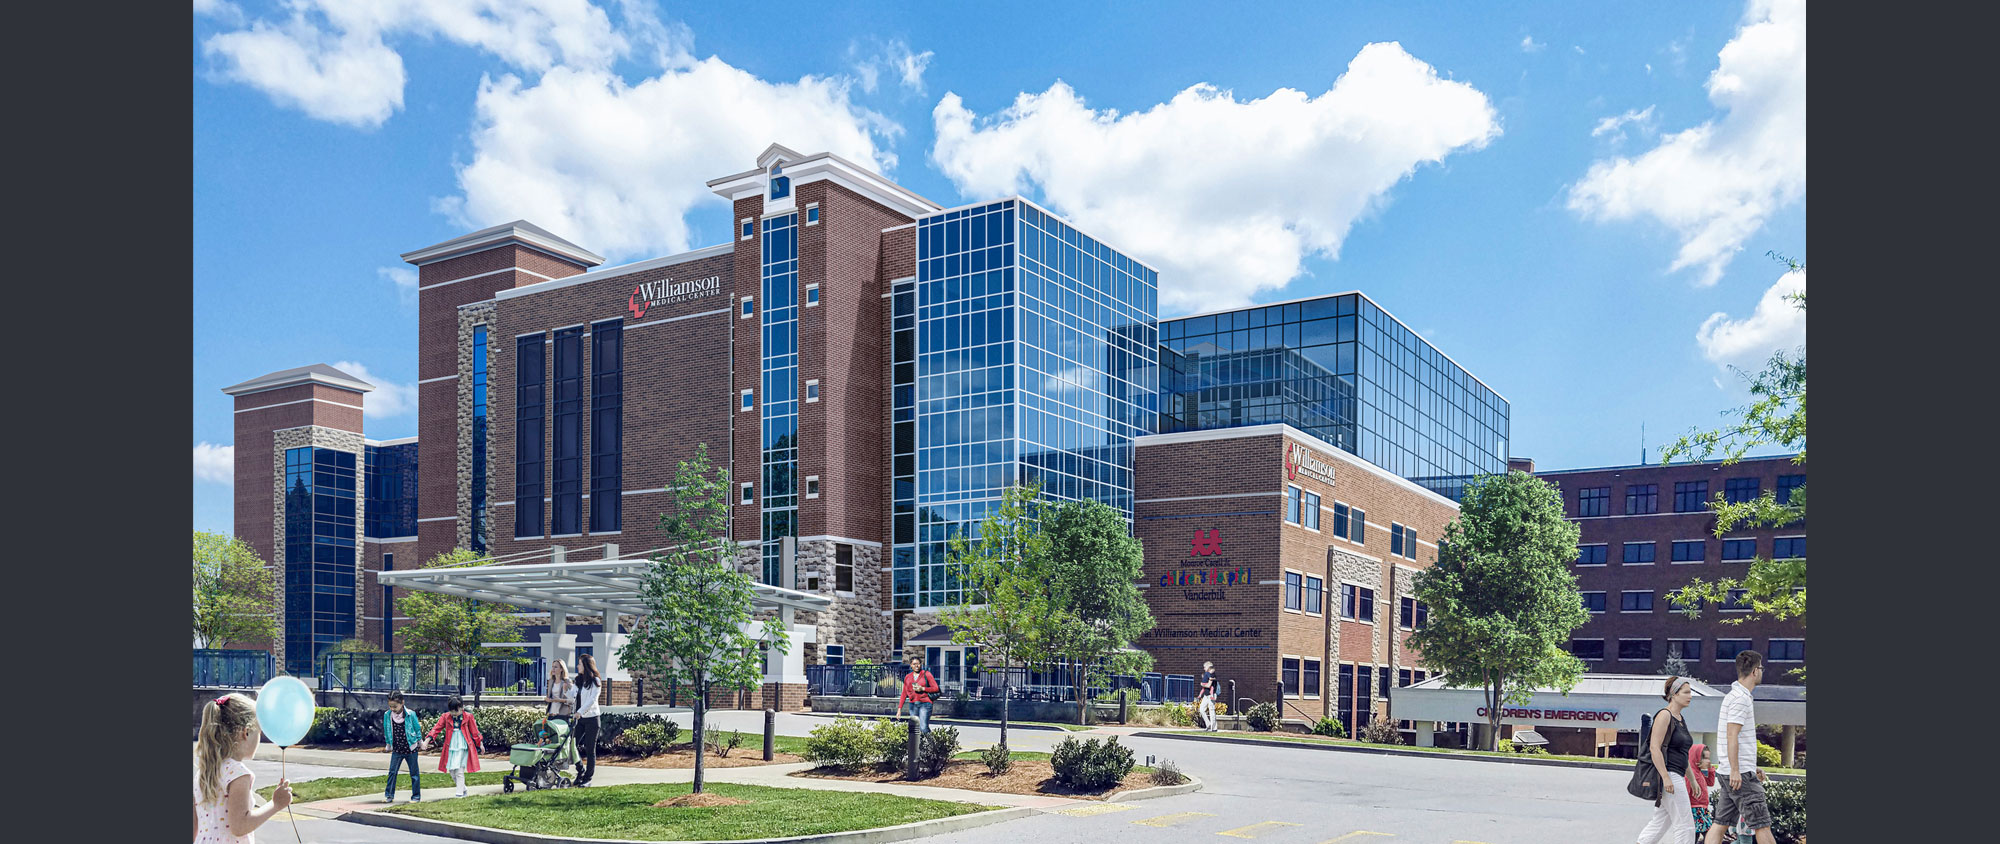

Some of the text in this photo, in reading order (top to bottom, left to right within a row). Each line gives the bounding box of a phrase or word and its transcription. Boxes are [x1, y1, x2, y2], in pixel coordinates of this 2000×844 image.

[639, 275, 720, 301] Williamson
[650, 289, 721, 307] MEDICAL CENTER
[1292, 442, 1336, 480] Williamson
[1209, 565, 1251, 587] Hospital
[1183, 589, 1225, 600] Vanderbilt
[1154, 628, 1198, 638] Williamson
[1200, 627, 1232, 638] Medical
[1234, 627, 1262, 638] Center
[1543, 709, 1618, 722] EMERGENCY
